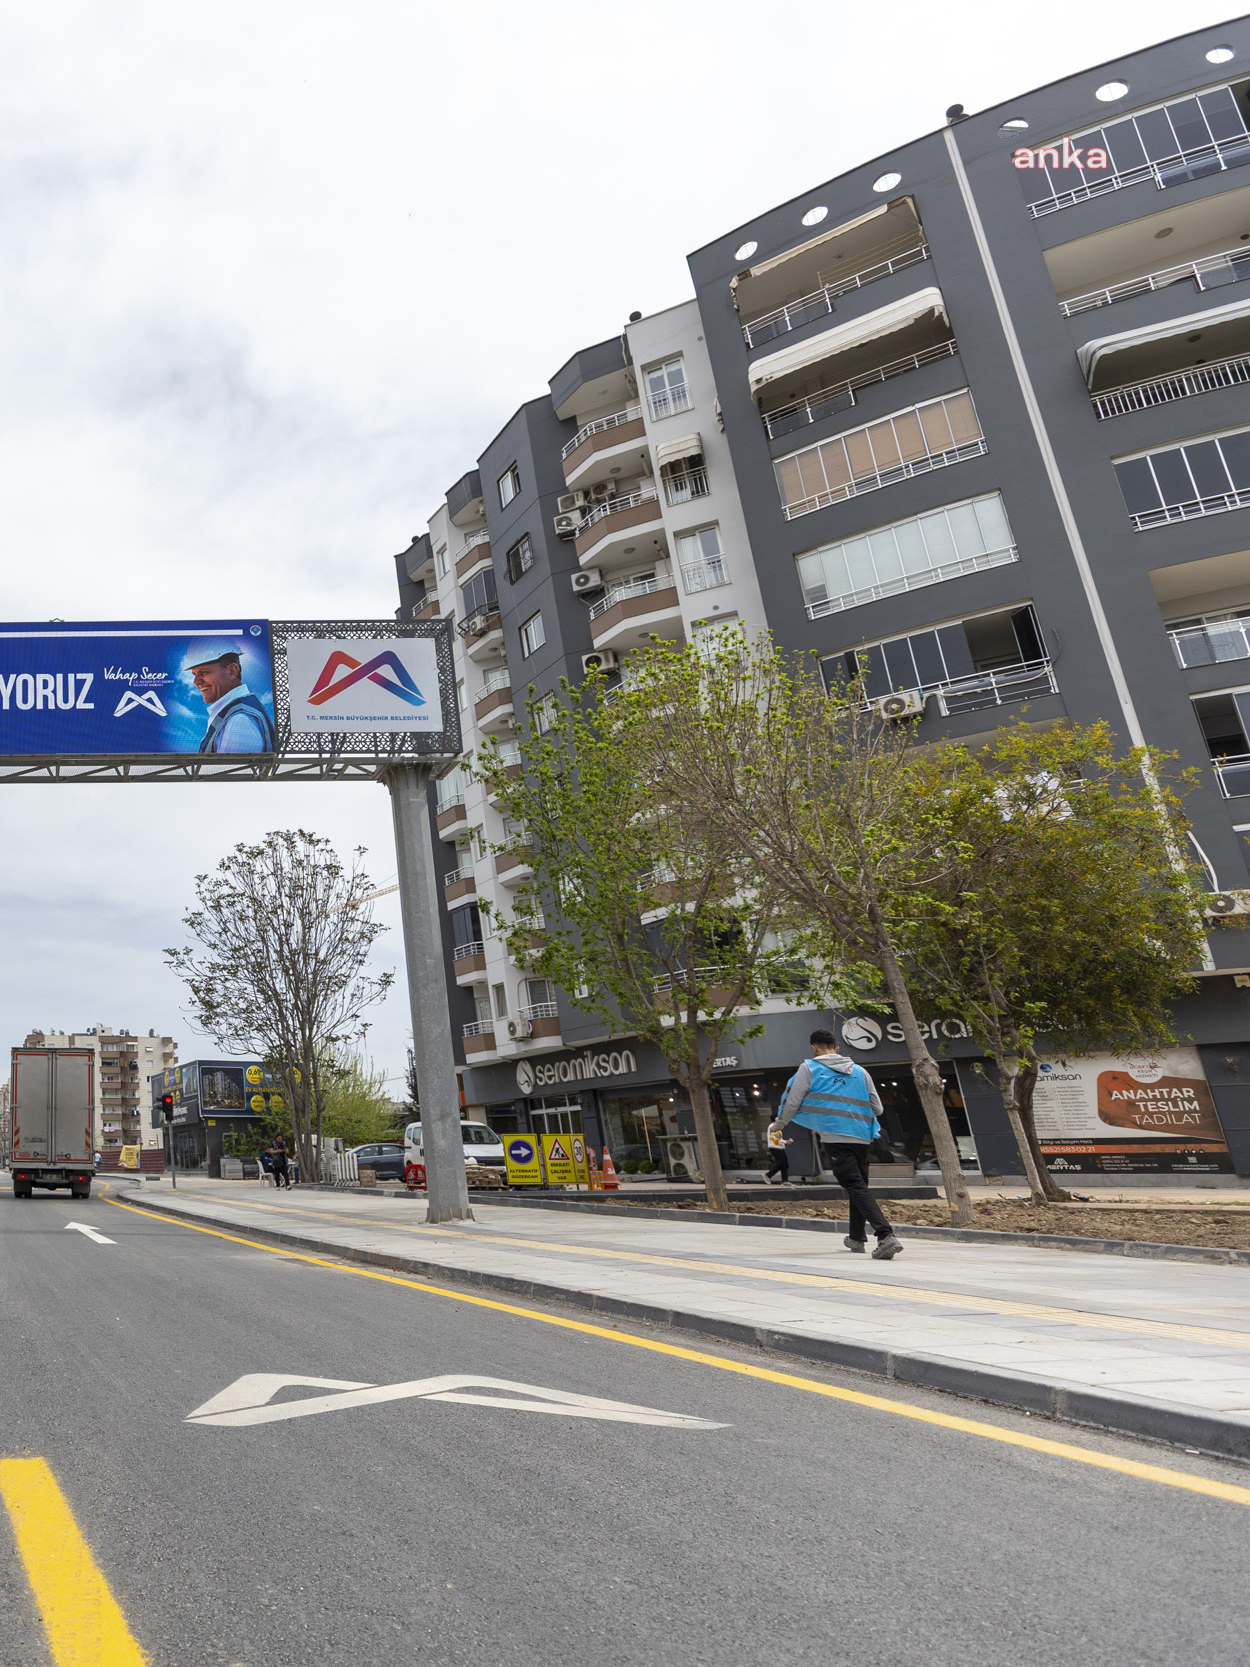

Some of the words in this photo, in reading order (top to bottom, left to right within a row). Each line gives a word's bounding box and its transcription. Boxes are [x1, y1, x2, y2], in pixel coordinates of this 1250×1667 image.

[103, 665, 138, 686] Vahap
[535, 1049, 637, 1086] seramiksan
[1034, 1073, 1082, 1082] amiksan
[1110, 1087, 1196, 1101] ANAHTAR
[1135, 1099, 1200, 1113] TESLİM
[1131, 1112, 1202, 1126] TADİLAT
[575, 1146, 582, 1156] 30
